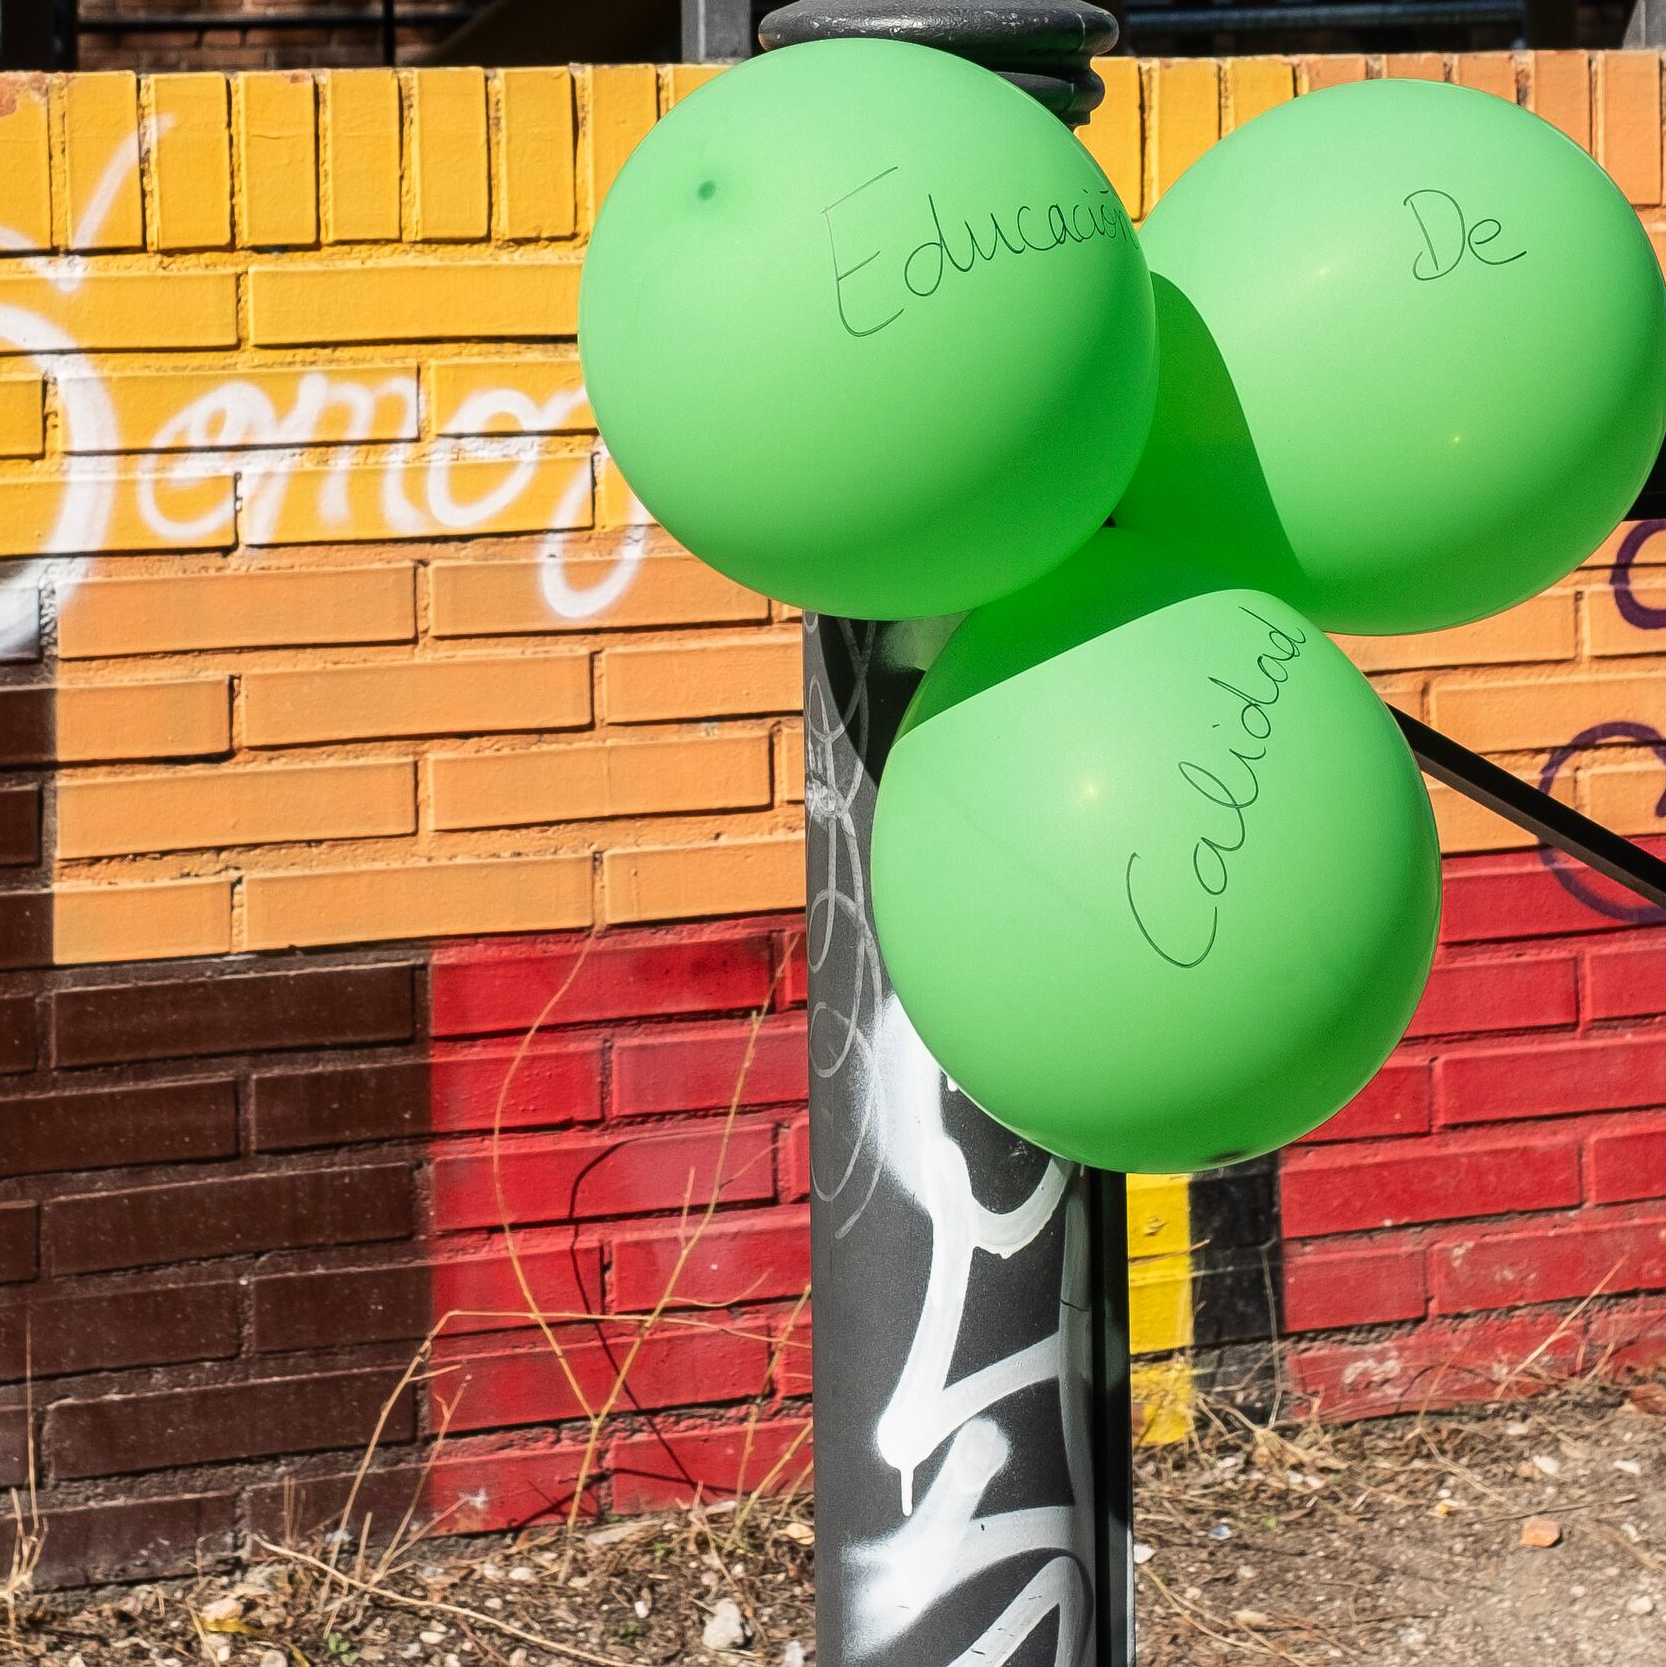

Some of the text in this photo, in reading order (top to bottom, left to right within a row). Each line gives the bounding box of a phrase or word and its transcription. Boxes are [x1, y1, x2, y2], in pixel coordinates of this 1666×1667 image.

[821, 165, 1140, 337] Educación
[1403, 187, 1528, 282] De
[1126, 605, 1306, 968] Calidad
